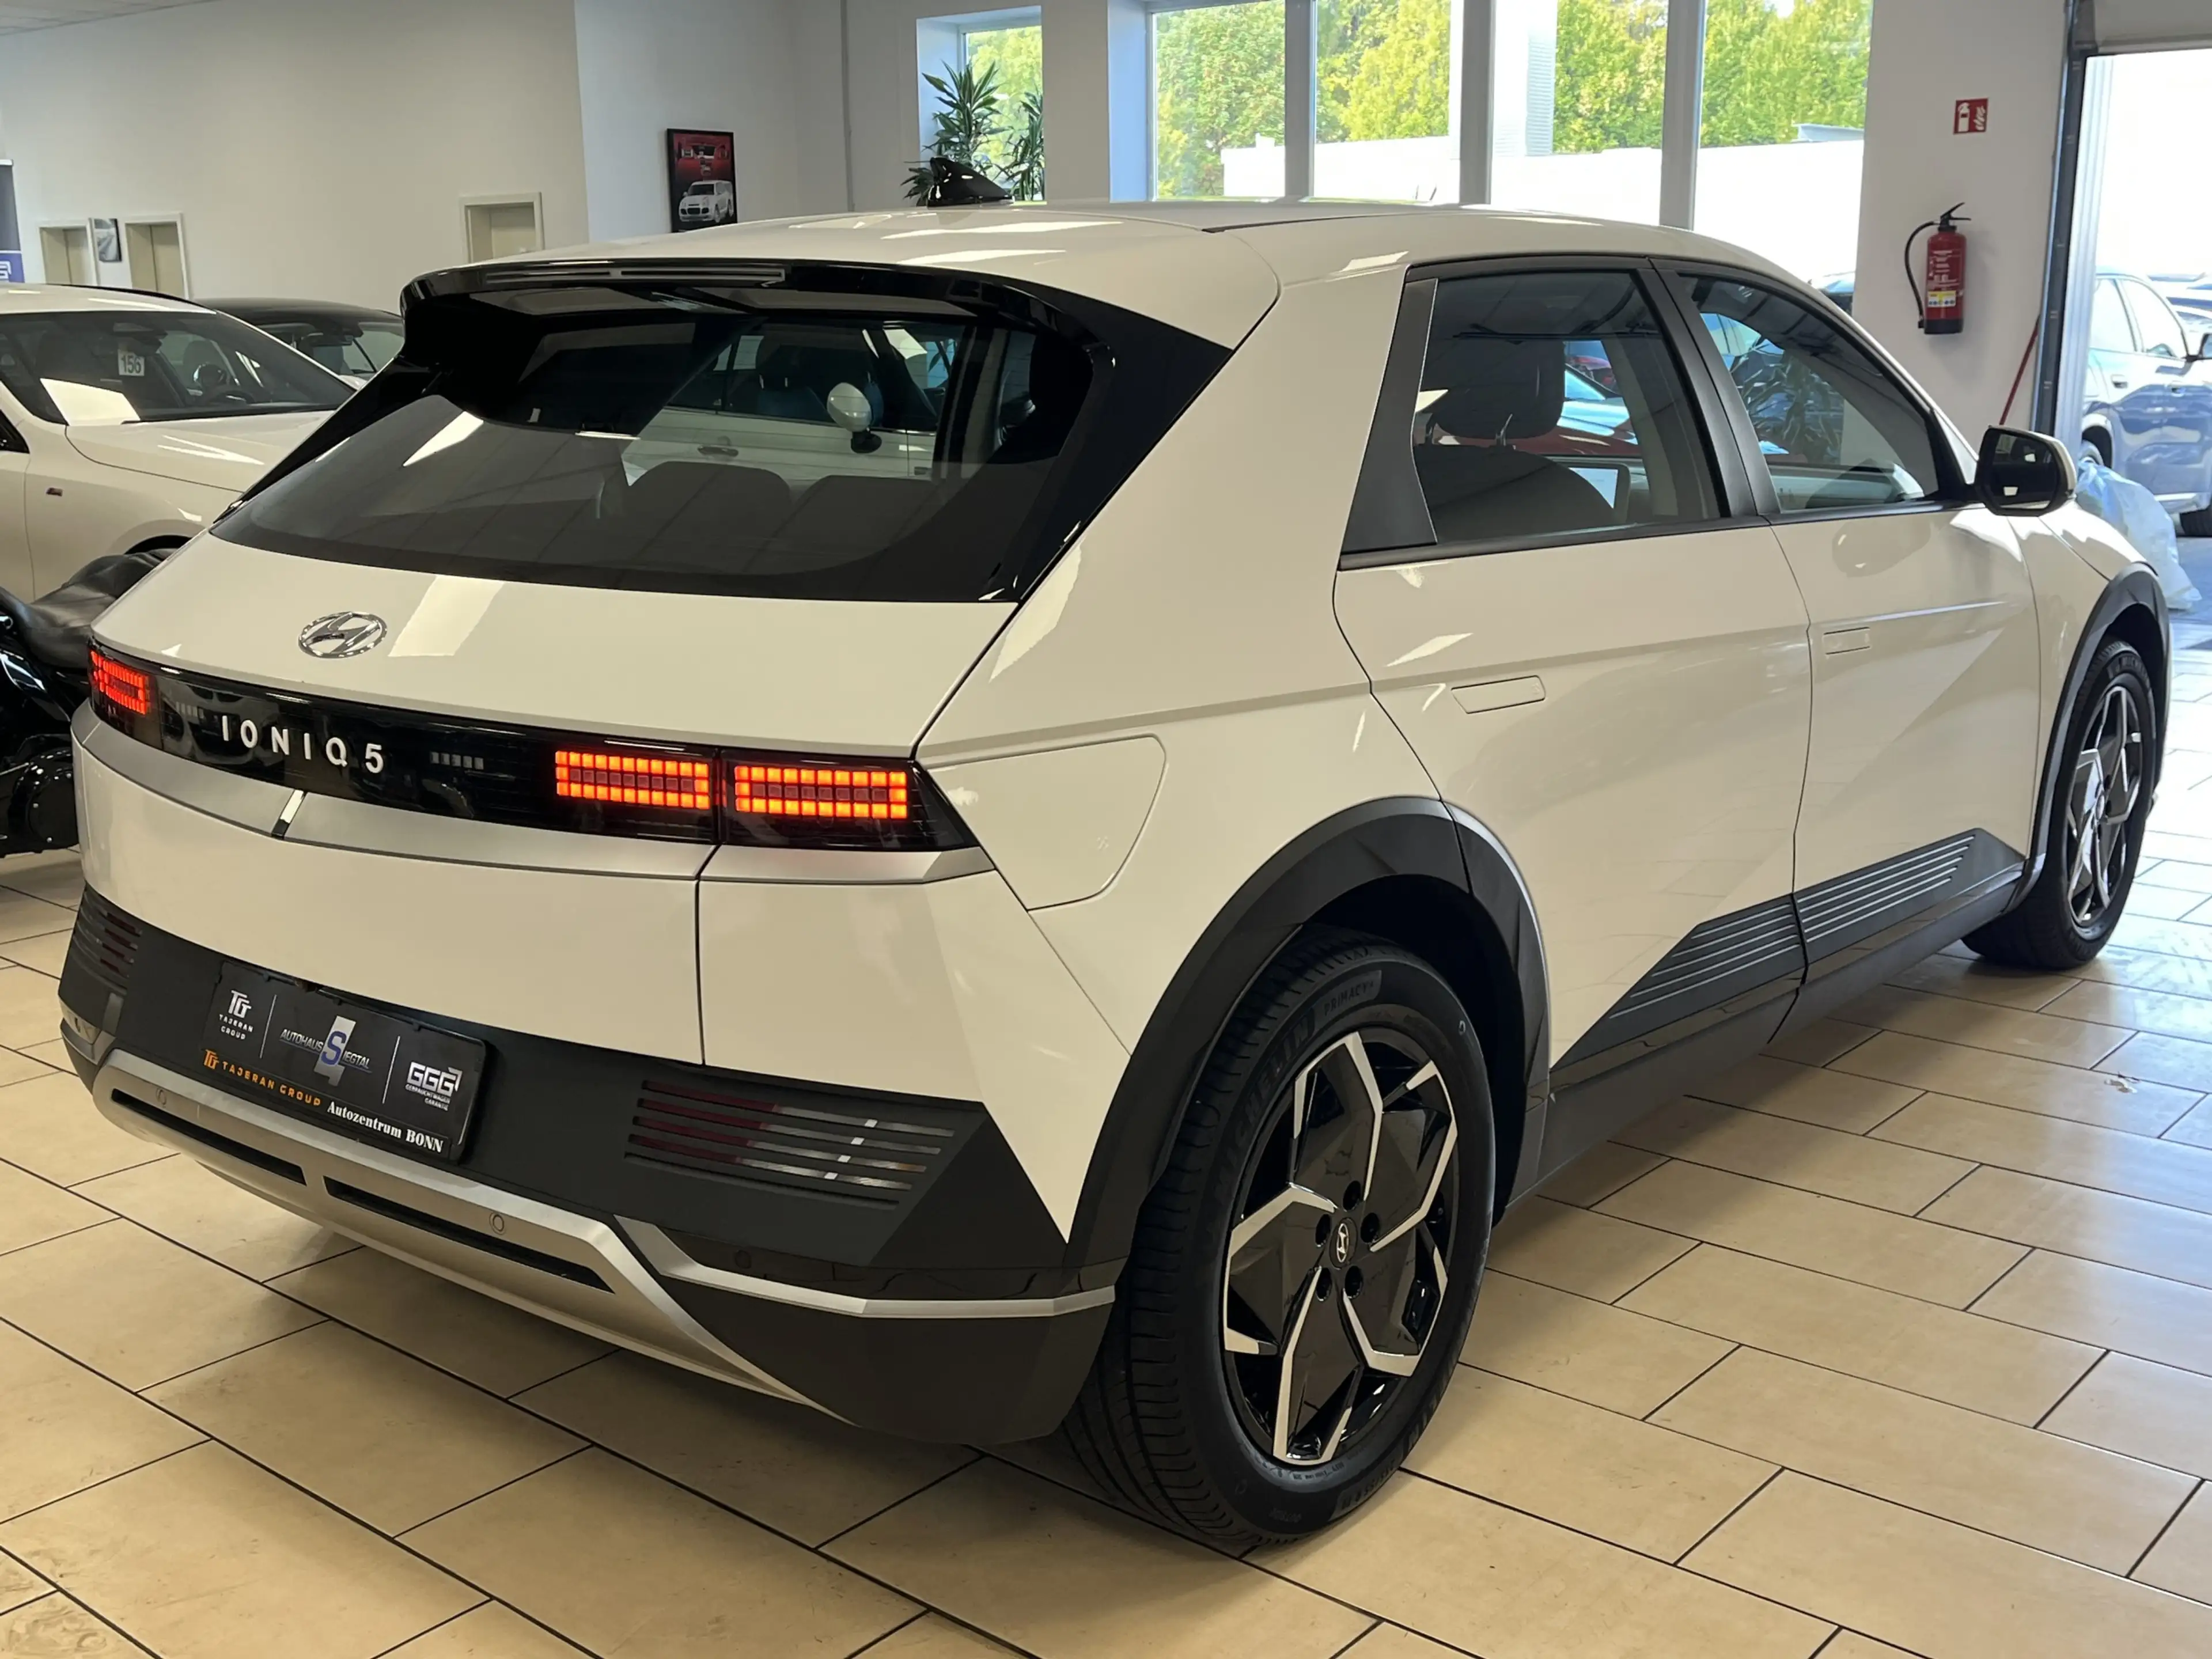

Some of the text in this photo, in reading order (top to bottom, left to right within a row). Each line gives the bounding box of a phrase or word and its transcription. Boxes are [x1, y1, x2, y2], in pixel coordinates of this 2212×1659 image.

[121, 355, 142, 374] 156
[222, 715, 384, 774] IONIQ 5
[1324, 981, 1366, 1016] PRIMACY
[220, 1026, 246, 1040] GROUP
[280, 1029, 324, 1052] AUTOHAUS
[222, 1061, 275, 1090] TAJERAN
[279, 1084, 321, 1107] GROUP
[407, 1061, 463, 1097] GGG
[327, 1101, 444, 1153] Autozentrum BONN
[1213, 1016, 1309, 1206] MICHELIN
